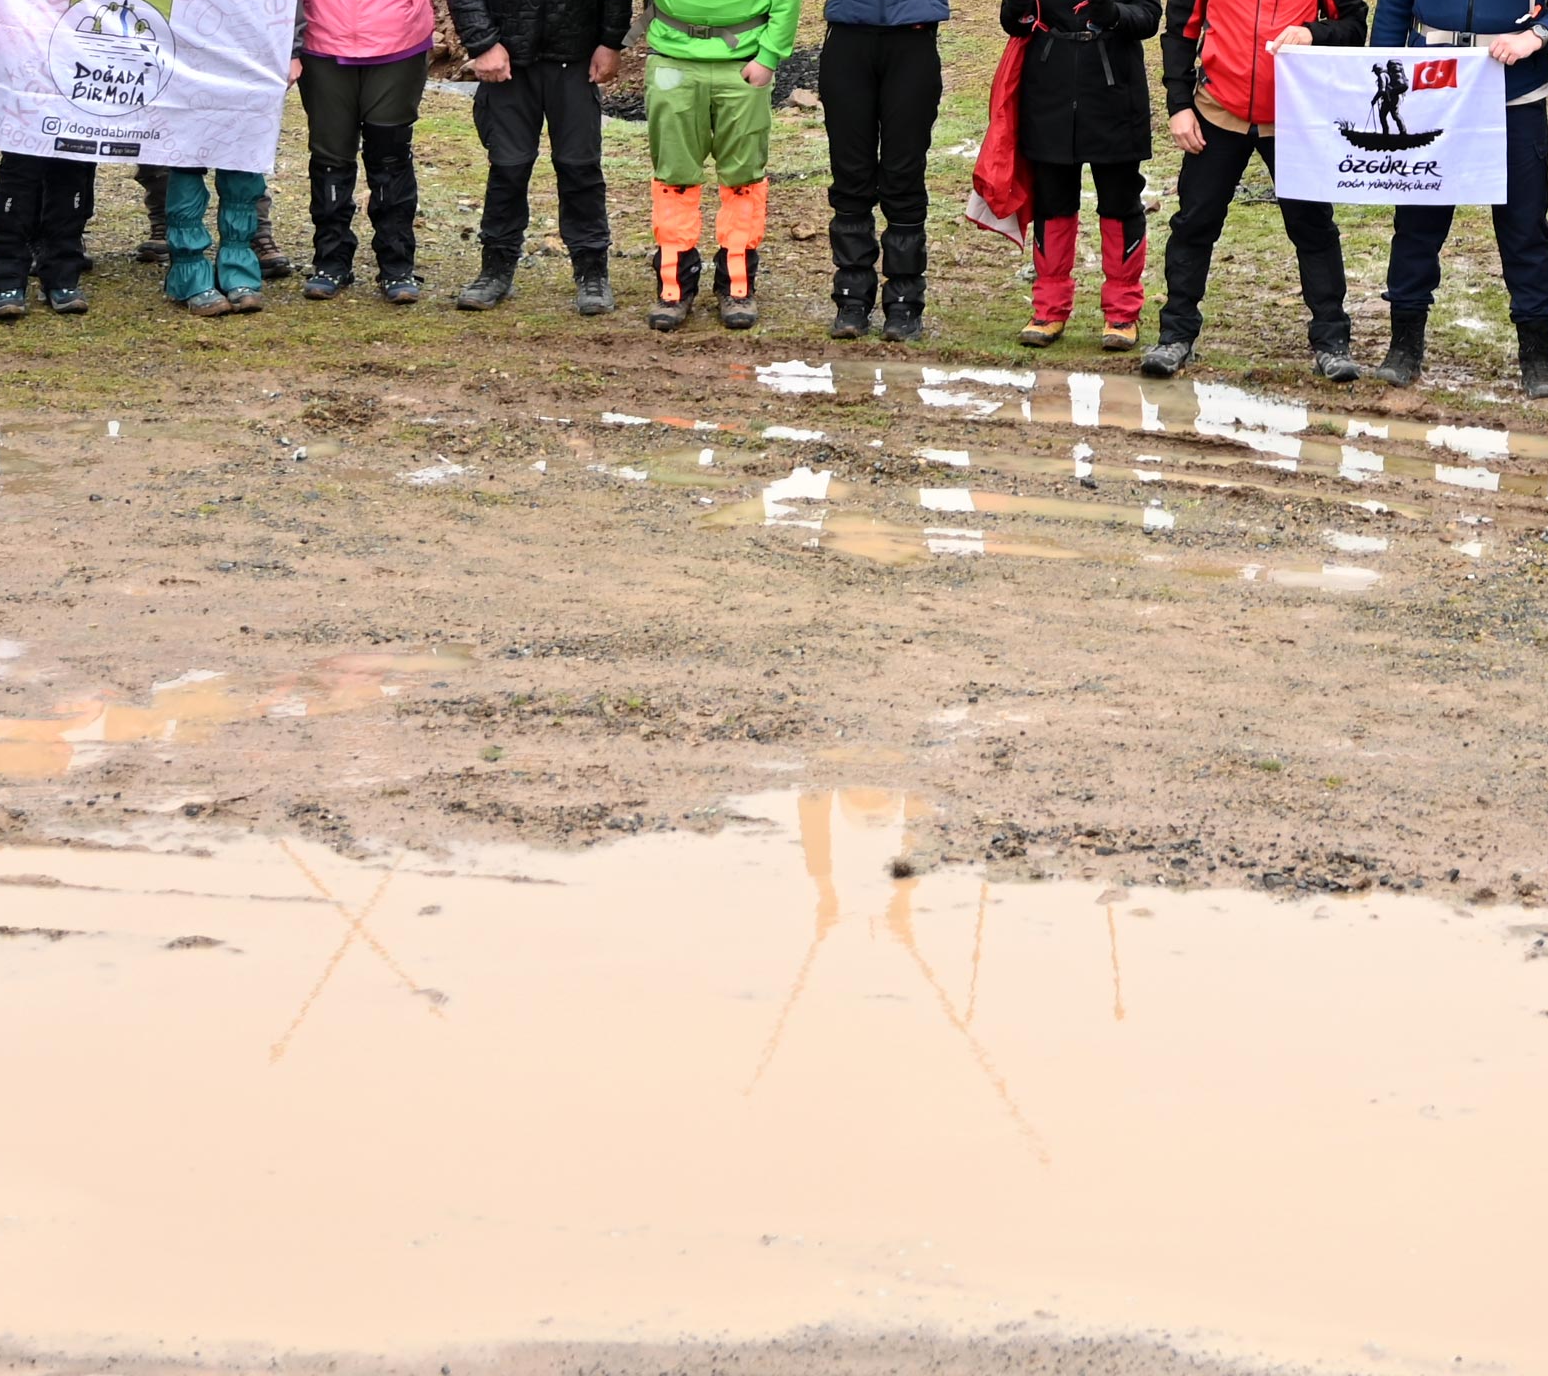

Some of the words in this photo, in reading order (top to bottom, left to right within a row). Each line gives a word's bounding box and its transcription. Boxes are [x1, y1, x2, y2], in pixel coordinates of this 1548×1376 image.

[73, 61, 145, 86] DOĞADA
[1338, 153, 1443, 178] ÖZGÜRLER
[1337, 178, 1365, 189] DOĞA
